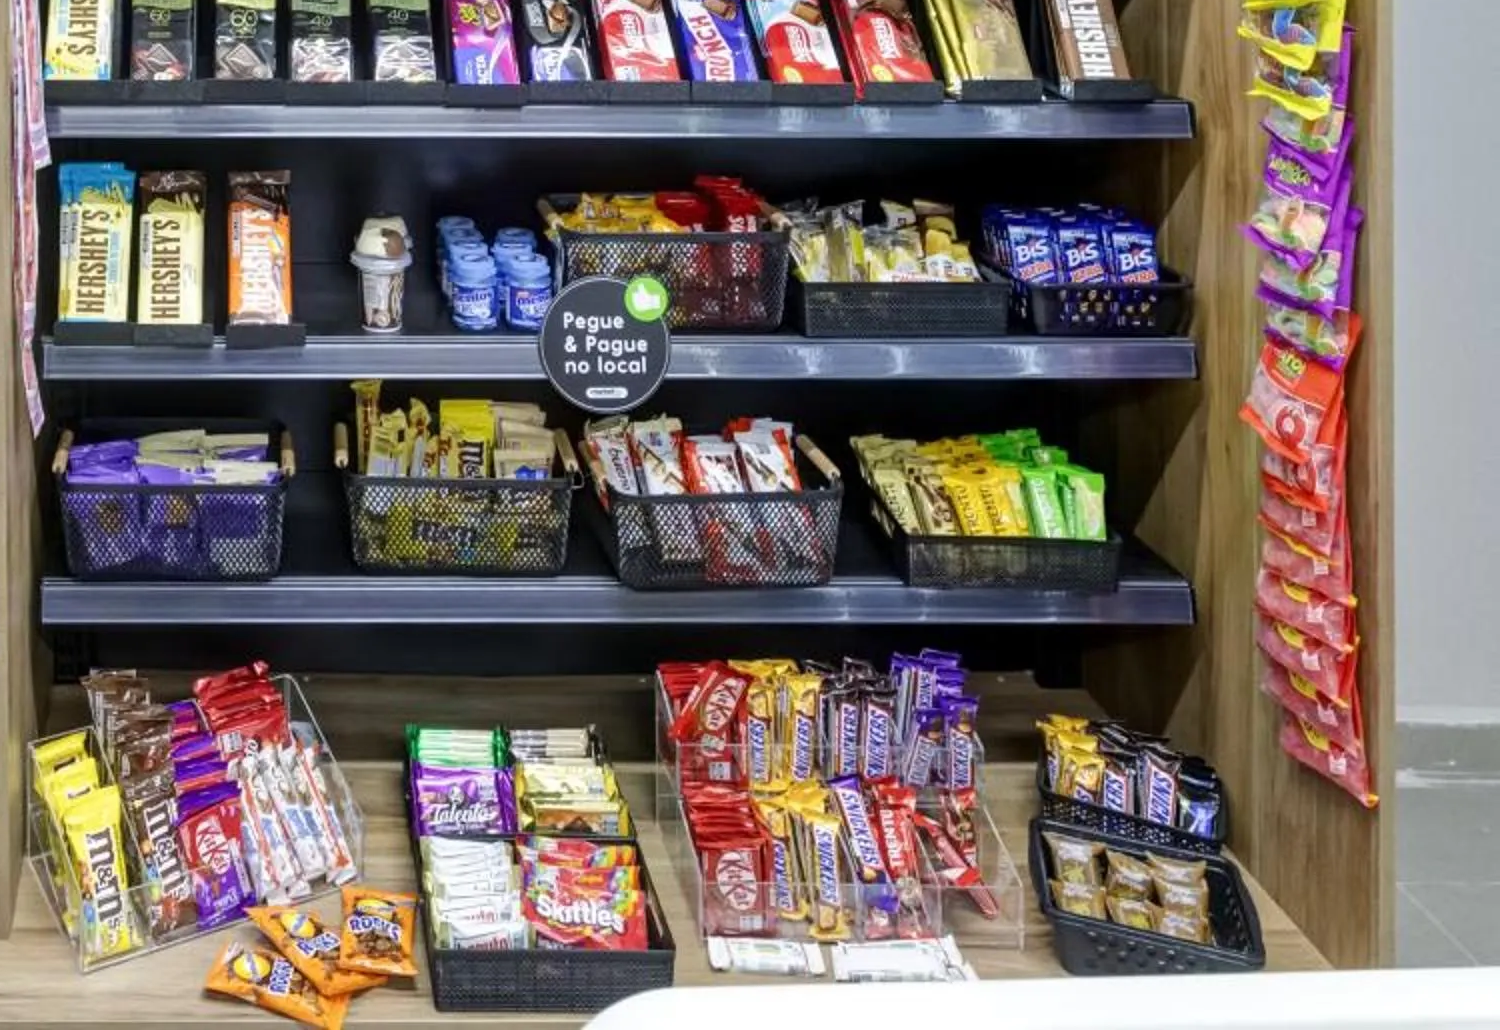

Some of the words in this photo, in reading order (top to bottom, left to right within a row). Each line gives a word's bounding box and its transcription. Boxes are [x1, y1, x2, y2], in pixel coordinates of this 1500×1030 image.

[75, 209, 111, 315] HERSHEY'S
[151, 219, 181, 319] HERSHEY'S
[1015, 238, 1050, 263] BIS
[1064, 244, 1101, 268] BIS
[1119, 248, 1155, 271] BIS
[563, 311, 625, 332] Pegue
[564, 336, 577, 353] &
[585, 336, 648, 356] Pague
[565, 359, 591, 374] no
[597, 356, 648, 374] local
[792, 717, 813, 782] SNICKERS
[866, 708, 890, 779] SNICKERS
[432, 803, 490, 823] Talento
[841, 789, 881, 867] SNICKERS
[196, 817, 232, 874] KitKat
[813, 826, 840, 906] SNICKERS
[716, 851, 759, 911] KitKat
[536, 895, 625, 935] Skittles
